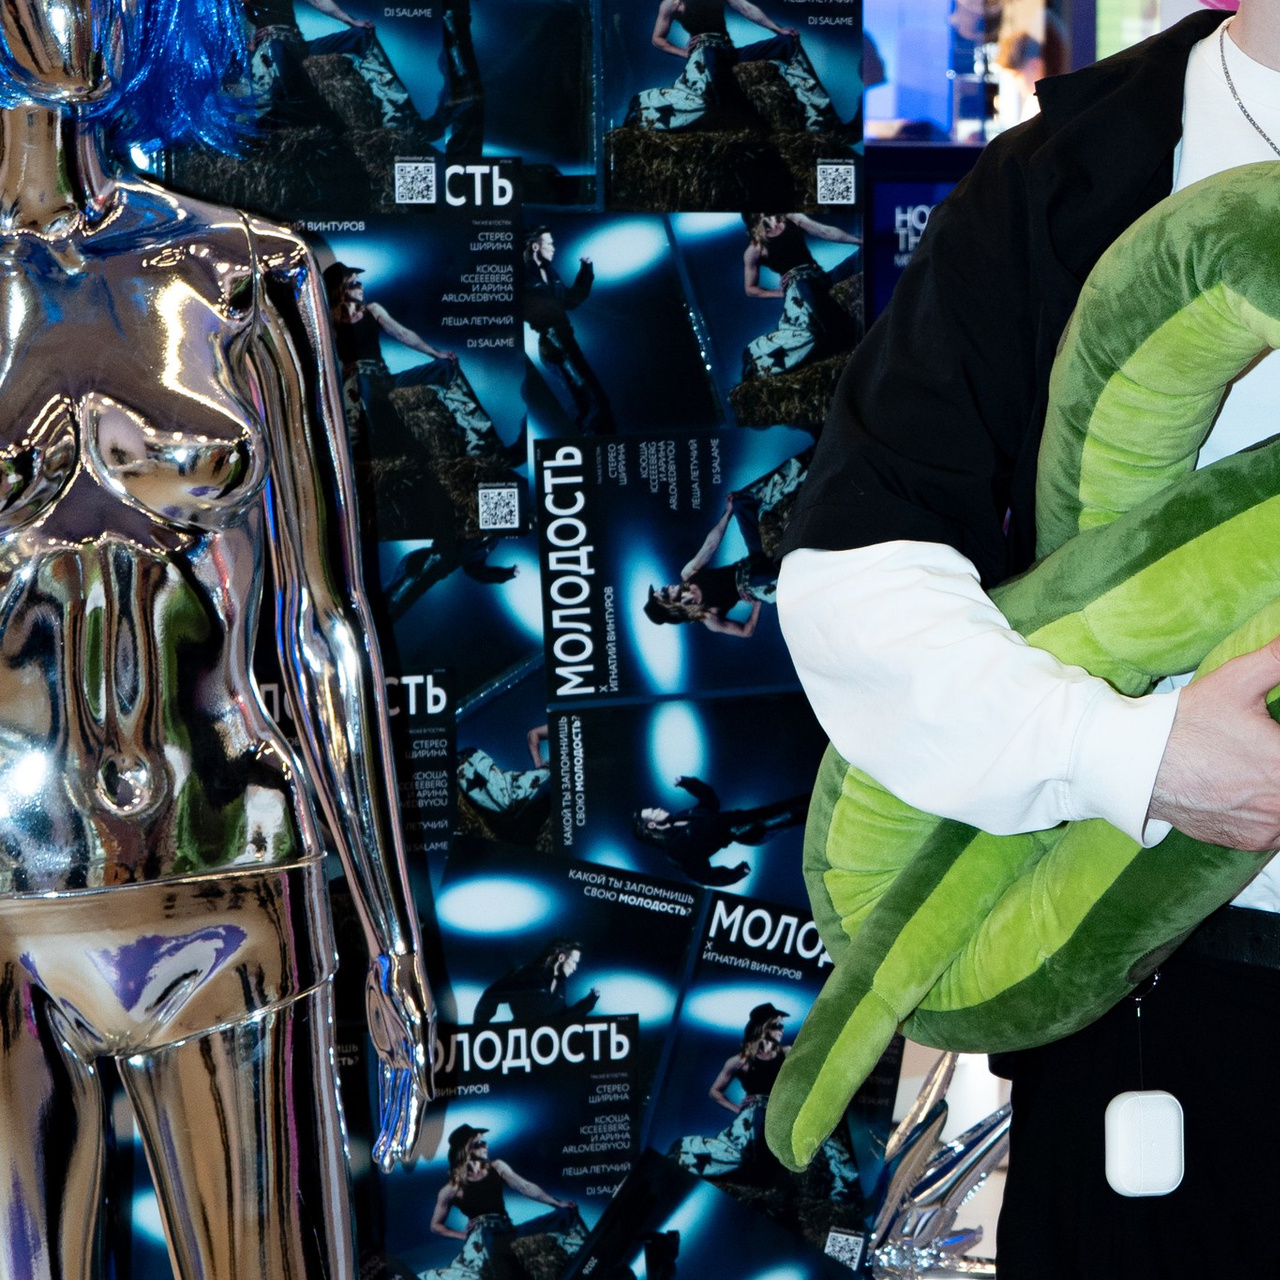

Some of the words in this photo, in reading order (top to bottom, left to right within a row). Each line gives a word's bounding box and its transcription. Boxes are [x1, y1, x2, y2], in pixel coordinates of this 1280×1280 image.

[384, 8, 394, 17] DJ
[396, 8, 432, 17] SALAME
[819, 16, 853, 26] SALAME
[307, 221, 365, 231] ВИНТУРОВ
[478, 232, 513, 241] СТЕРЕО
[470, 242, 513, 251] ШИРИНА
[476, 264, 513, 273] КСЮША
[481, 283, 513, 292] АРИНА
[470, 315, 513, 325] ЛЕТУЧИЙ
[467, 339, 476, 348] DJ
[478, 338, 514, 347] SALAME
[543, 445, 596, 696] МОЛОДОСТЬ
[604, 586, 615, 641] ВИНТУРОВ
[606, 643, 618, 691] ИГНАТИЙ
[558, 716, 571, 790] ЗАПОМНИШЬ
[571, 715, 584, 792] МОЛОДОСТЬ?
[562, 792, 571, 807] ТЫ
[575, 793, 585, 826] СВОЮ
[561, 808, 573, 846] КАКОЙ
[568, 869, 606, 885] КАКОЙ
[608, 878, 623, 890] ТЫ
[623, 881, 695, 904] ЗАПОМНИШЬ
[583, 886, 617, 902] СВОЮ
[618, 893, 692, 917] МОЛОДОСТЬ?
[702, 951, 749, 969] ИГНАТИЙ
[750, 961, 802, 980] ВИНТУРОВ
